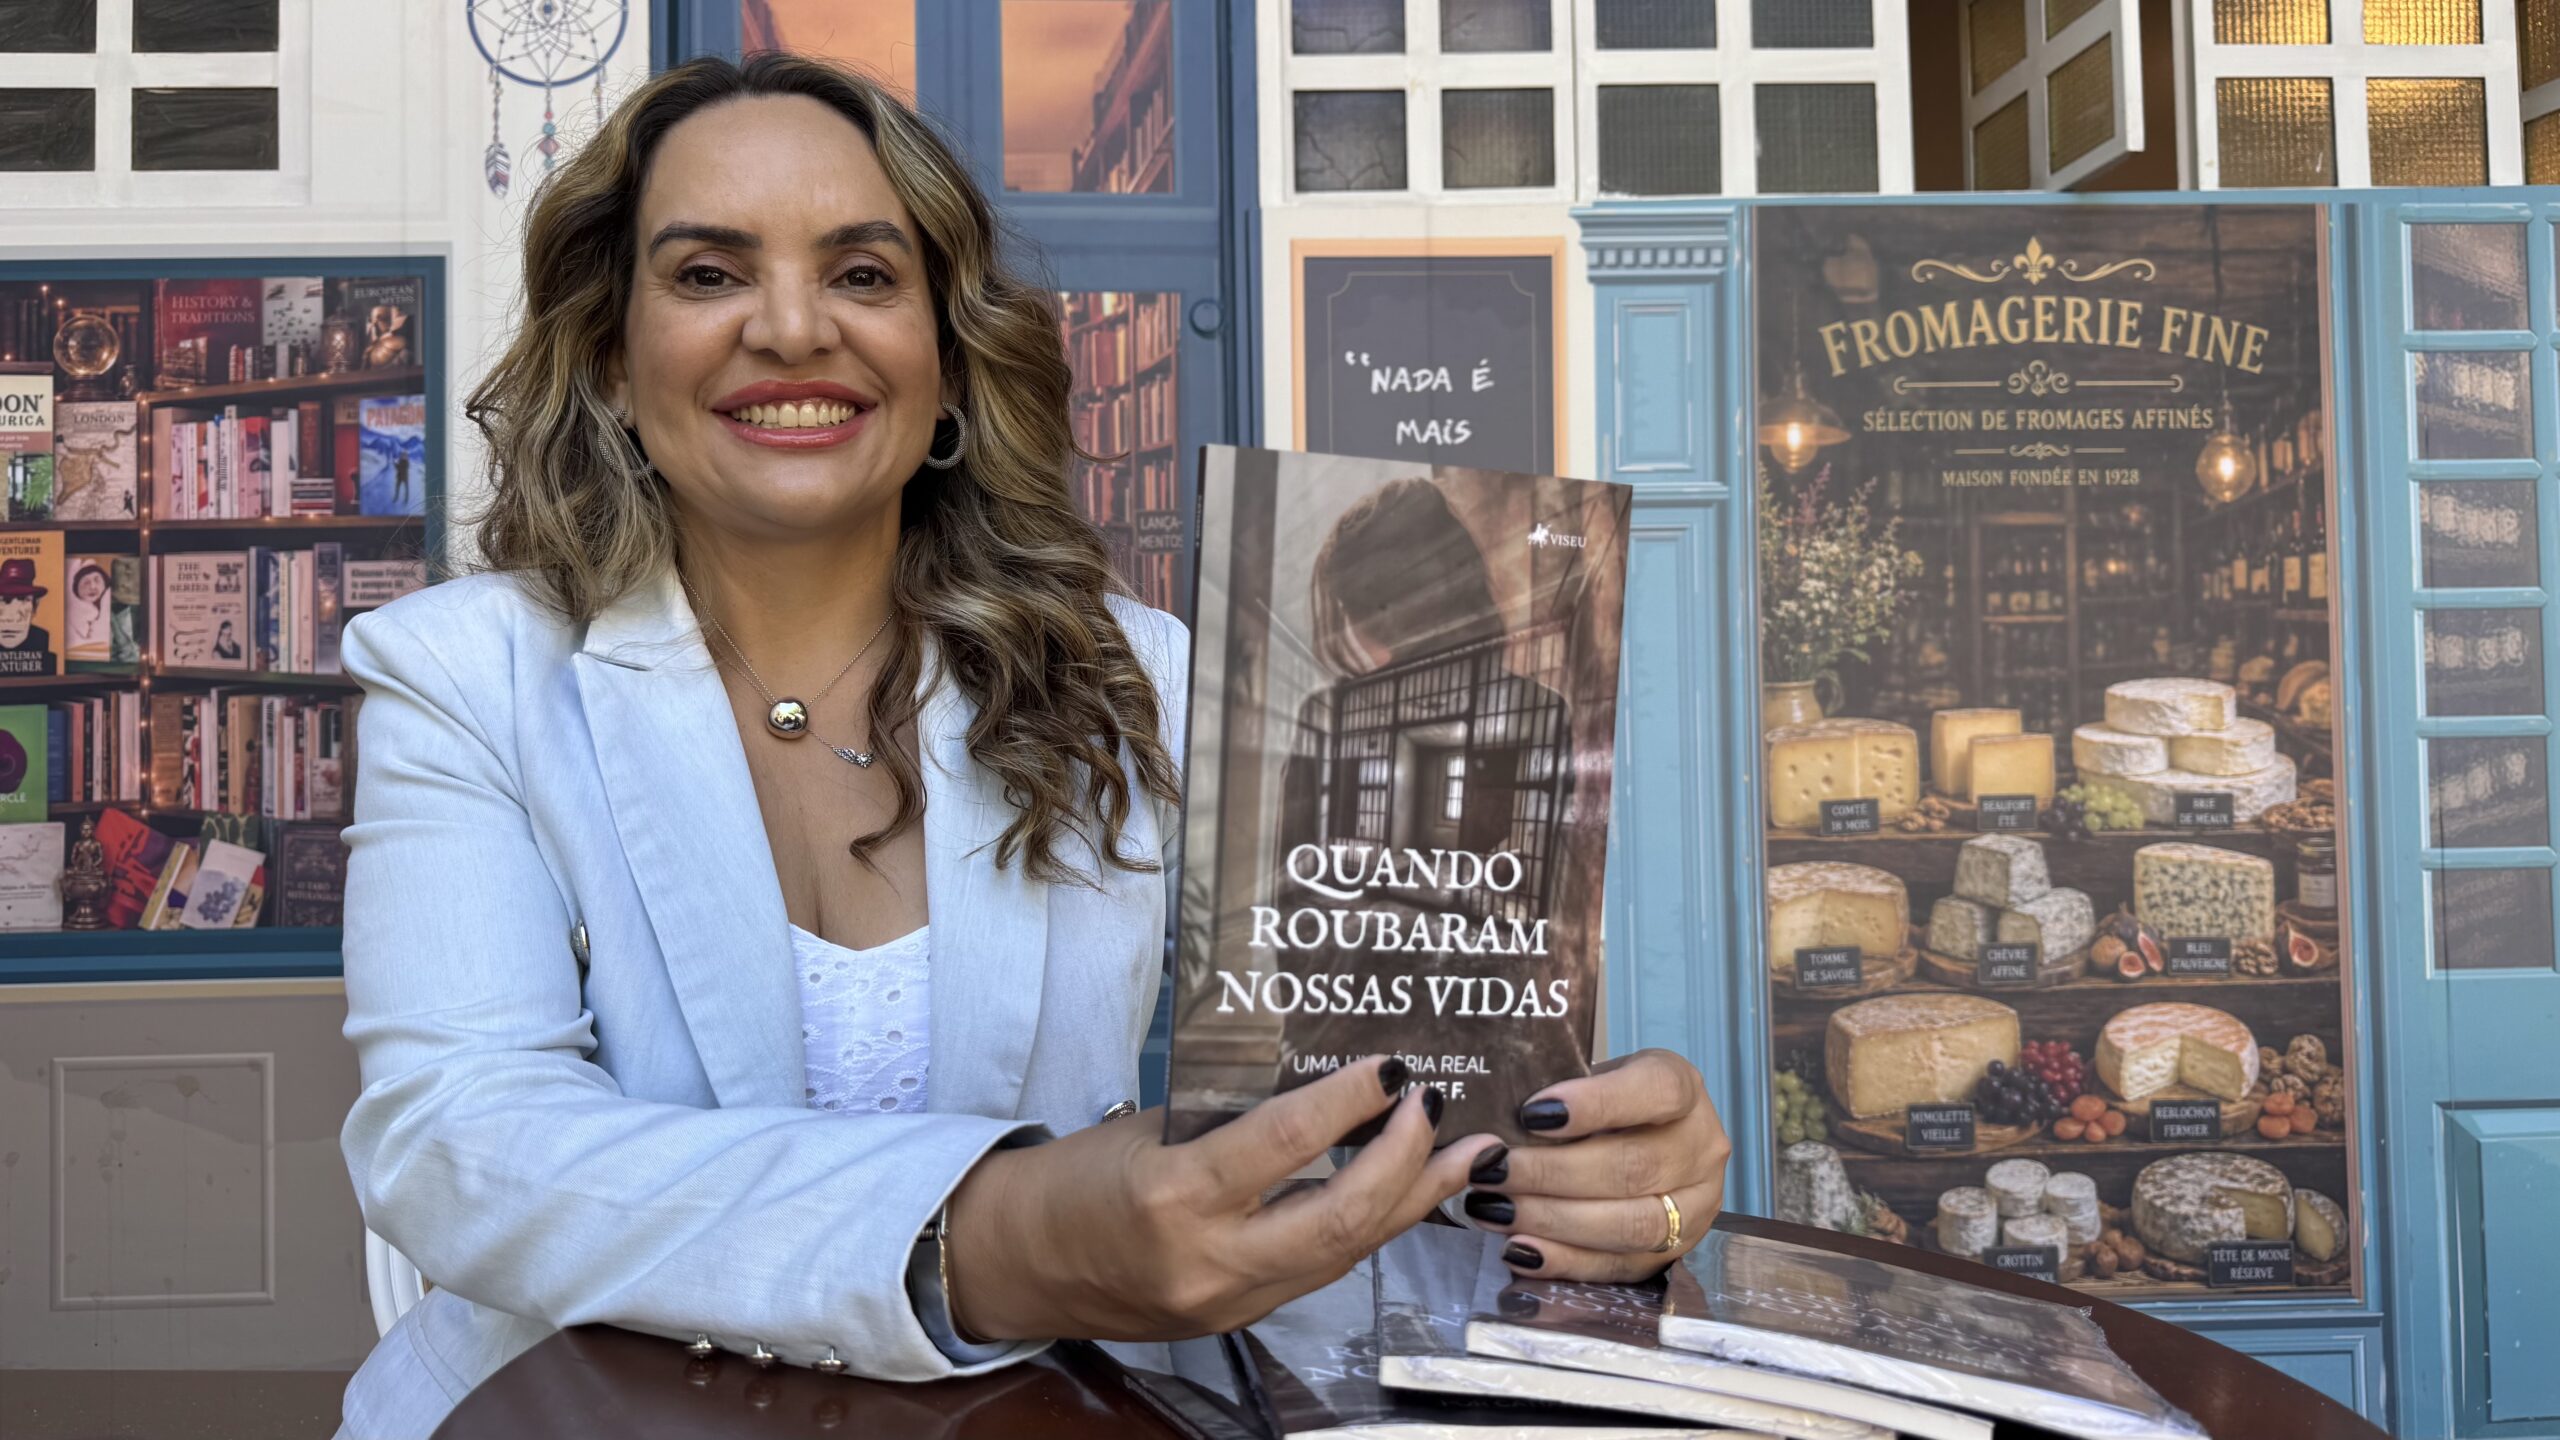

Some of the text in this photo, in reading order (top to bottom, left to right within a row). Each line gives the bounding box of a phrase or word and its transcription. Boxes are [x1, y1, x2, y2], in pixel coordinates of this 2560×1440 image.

[171, 295, 253, 309] HISTORY &
[170, 311, 255, 324] TRADITIONS
[1818, 295, 2270, 377] FROMAGERIE FINE
[1471, 358, 1495, 392] É
[74, 413, 125, 425] LONDON
[1863, 404, 2214, 432] SÉLECTION DE FROMAGES AFFINÉS
[1942, 466, 2140, 487] MAISON FONDÉE EN 1928
[1550, 533, 1588, 548] VISEU
[1286, 844, 1523, 900] QUANDO
[1247, 905, 1549, 955] ROUBARAM
[1216, 970, 1570, 1018] NOSSAS VIDAS
[1293, 1055, 1340, 1073] UMA
[1440, 1055, 1492, 1074] REAL
[1452, 1082, 1466, 1100] F.
[1996, 1254, 2045, 1267] CROTTIN
[2241, 1249, 2256, 1262] DE
[2258, 1248, 2290, 1261] MOINE
[1520, 1291, 1659, 1322] NOSS
